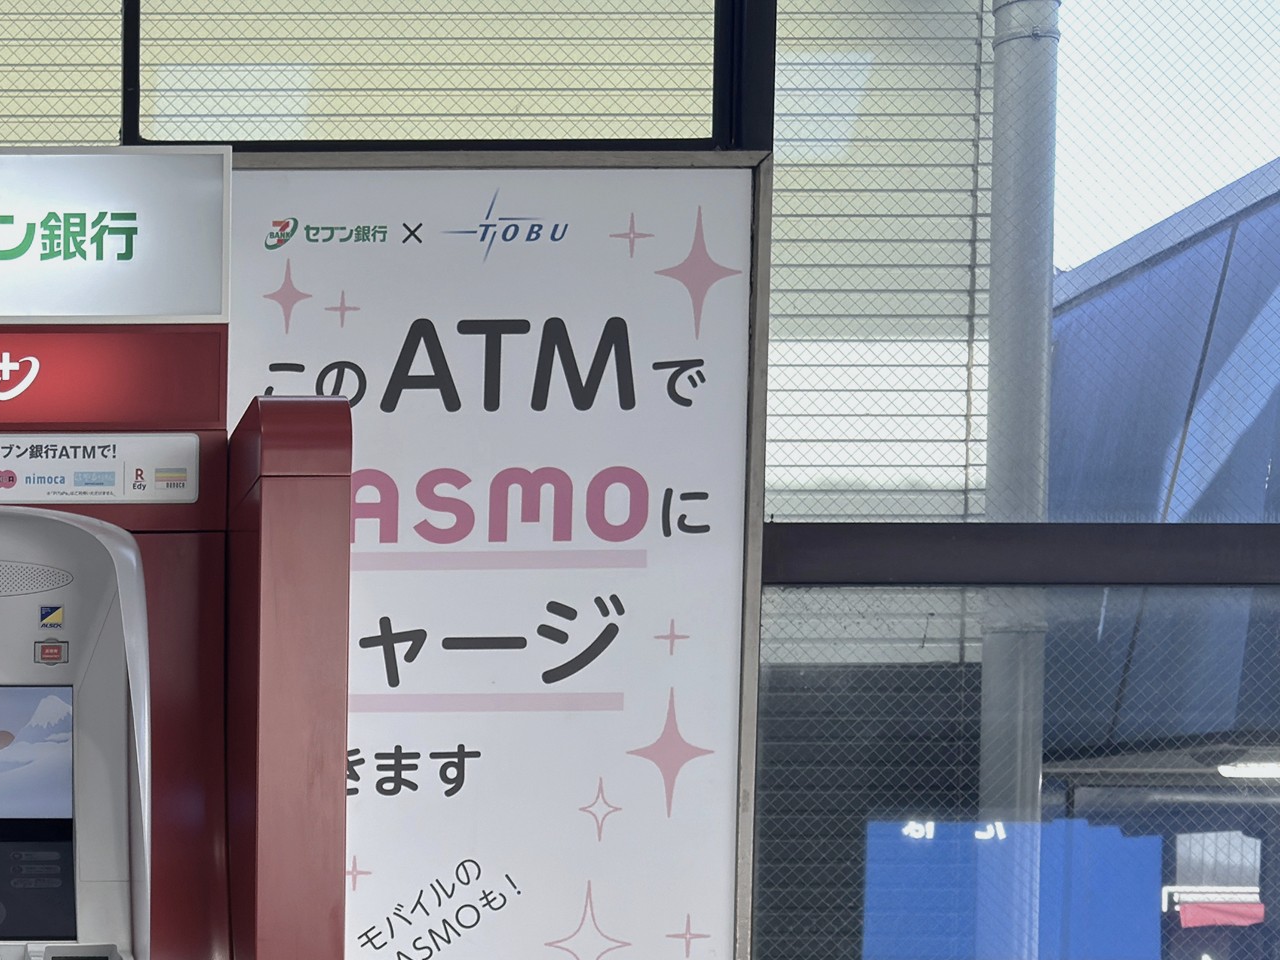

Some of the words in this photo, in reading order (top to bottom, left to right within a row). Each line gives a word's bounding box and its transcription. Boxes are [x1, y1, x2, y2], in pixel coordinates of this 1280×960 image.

[269, 231, 292, 239] BANK
[304, 224, 387, 243] セブン銀行
[478, 223, 569, 242] TOBU
[25, 473, 66, 485] nimoca
[132, 482, 147, 491] Edy
[357, 858, 482, 951] モバイルの
